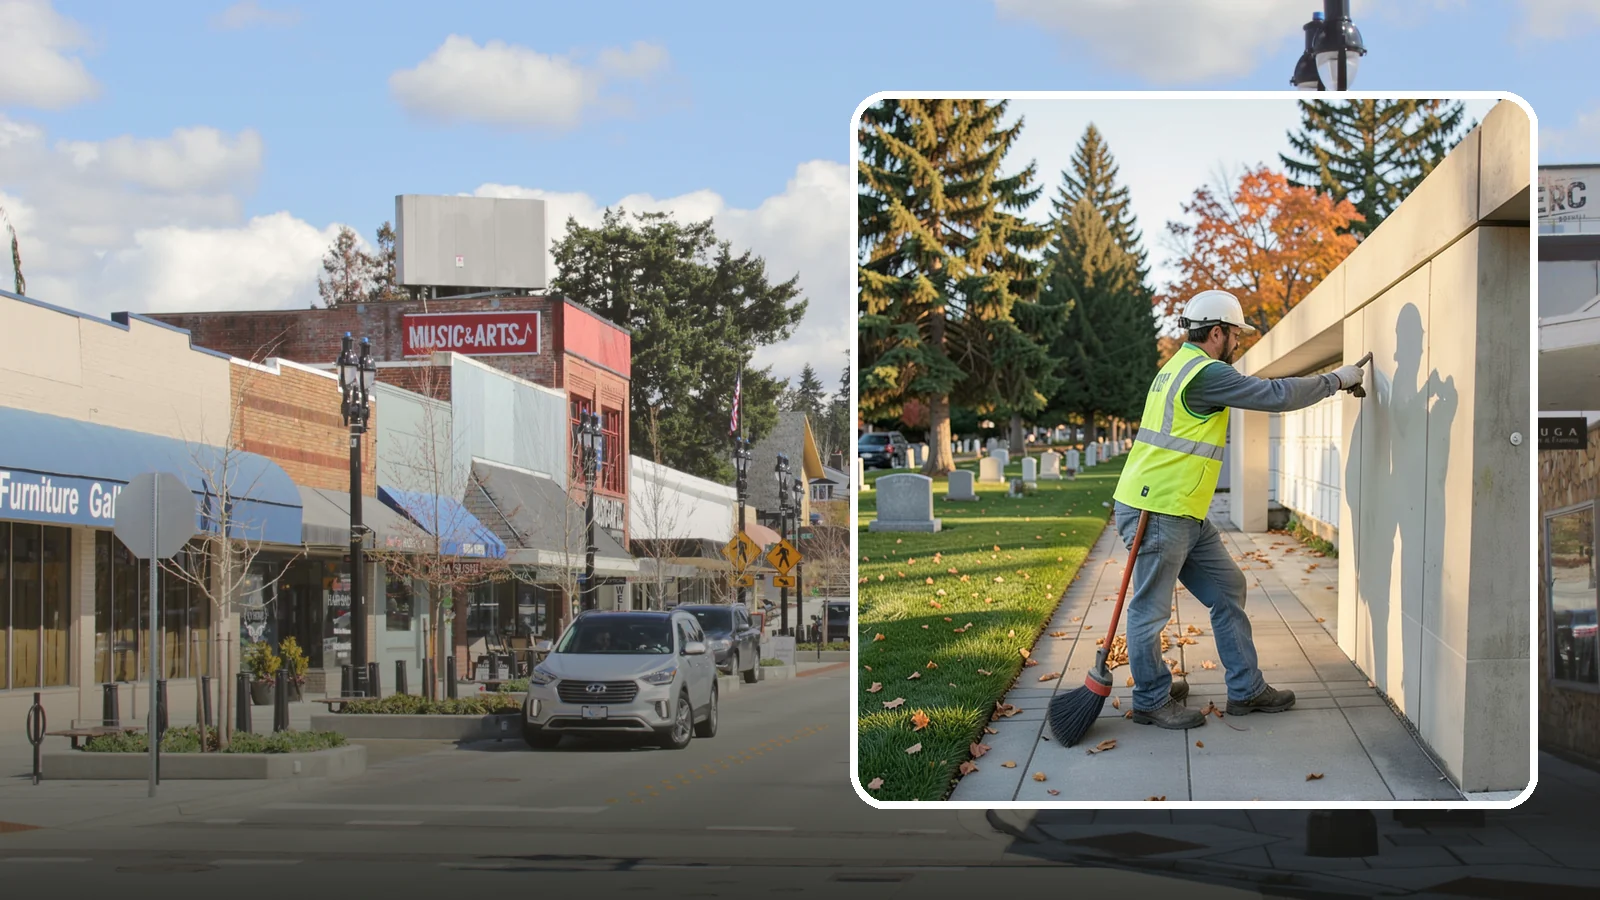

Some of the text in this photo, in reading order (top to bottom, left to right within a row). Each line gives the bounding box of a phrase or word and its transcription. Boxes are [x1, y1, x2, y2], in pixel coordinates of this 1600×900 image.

[408, 322, 520, 349] MUSIC&ARTS
[0, 471, 122, 519] Furniture Gal
